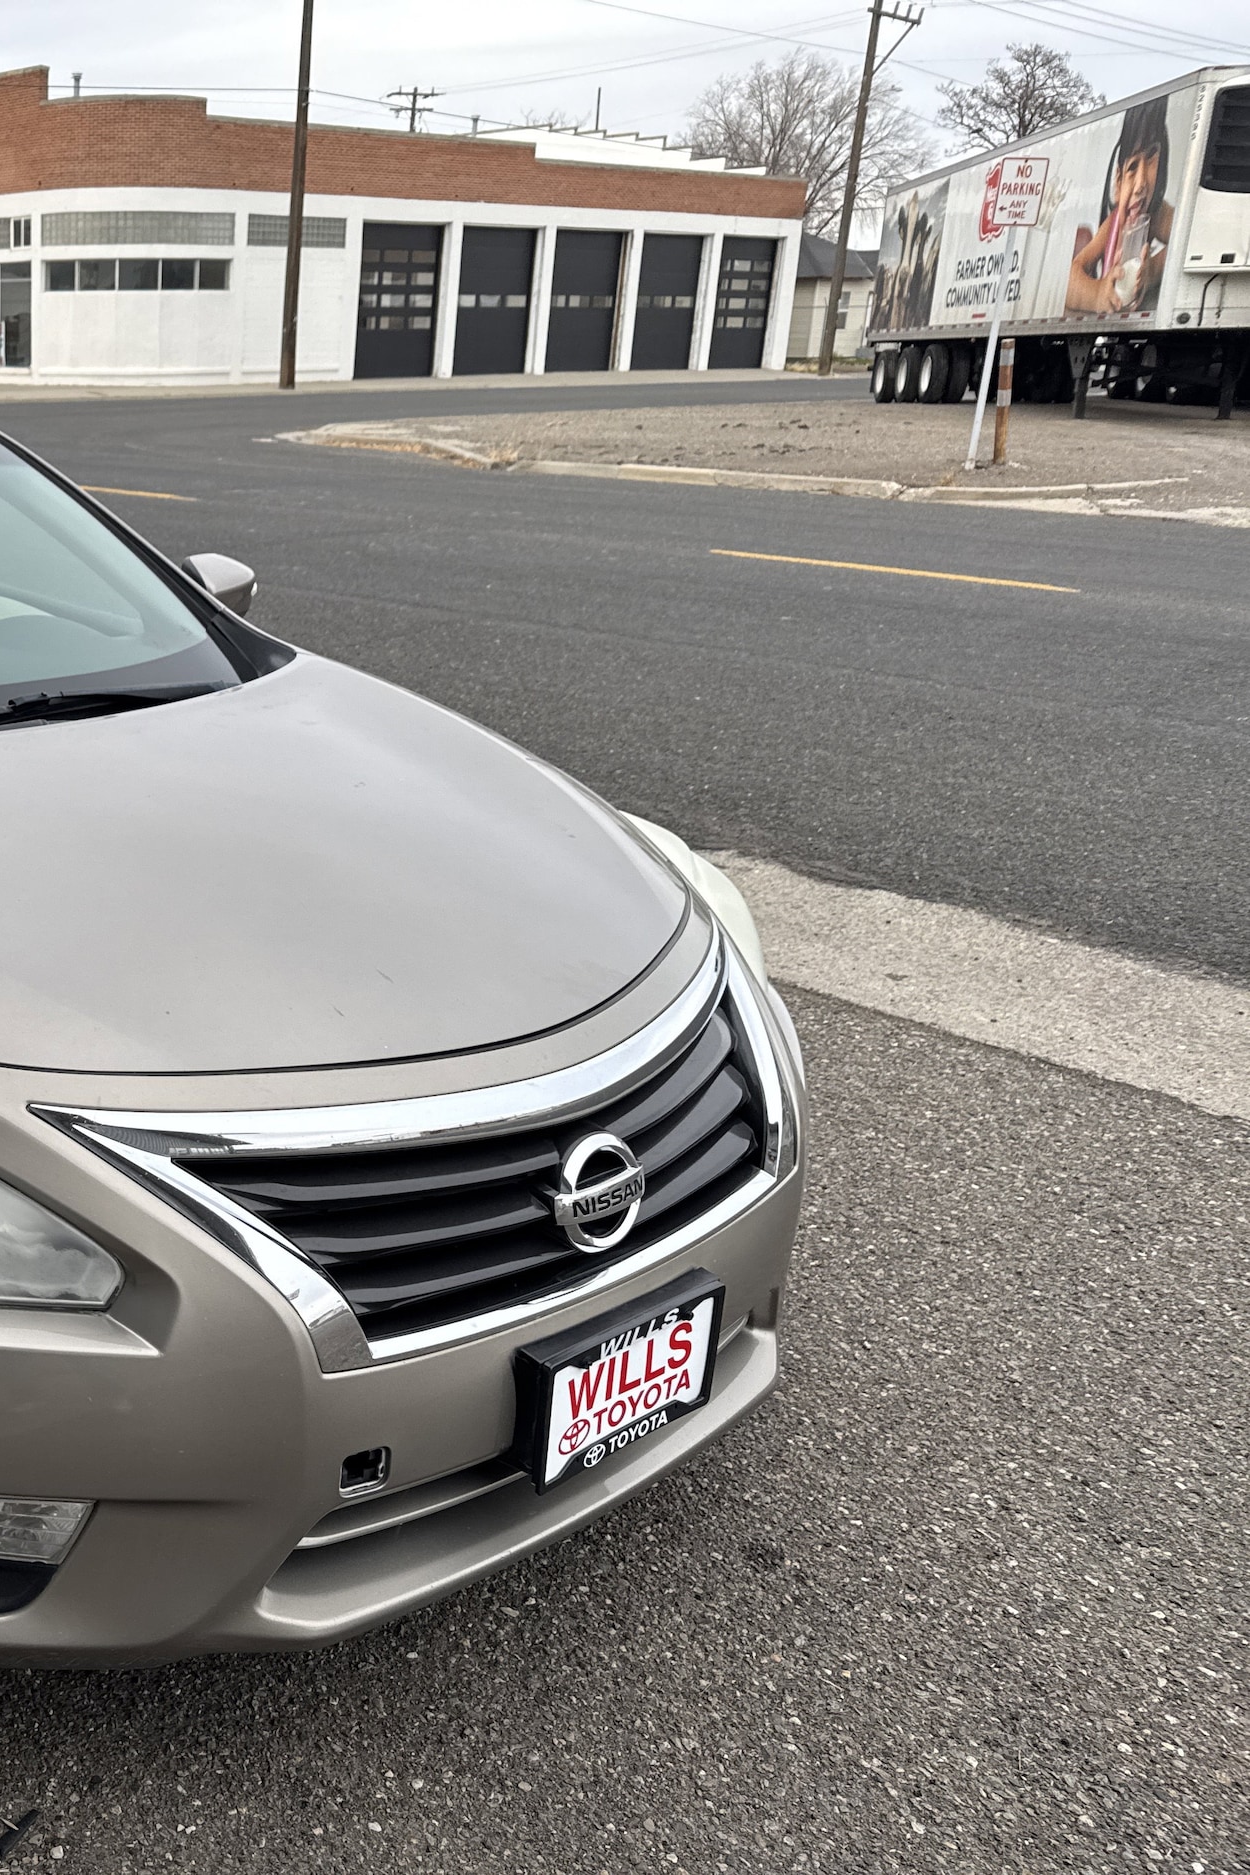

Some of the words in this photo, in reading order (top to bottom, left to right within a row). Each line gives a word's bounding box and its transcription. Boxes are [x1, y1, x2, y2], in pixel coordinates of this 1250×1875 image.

[1016, 164, 1033, 178] NO
[1000, 182, 1042, 196] PARKING
[1007, 210, 1027, 220] TIME
[1009, 199, 1029, 209] ANY
[956, 256, 986, 281] FARMER
[946, 282, 993, 308] COMMUNITY
[571, 1175, 645, 1219] NISSAN
[599, 1306, 681, 1359] WILLS
[568, 1321, 693, 1420] WILLS
[592, 1367, 691, 1436] TOYOTA
[608, 1413, 669, 1454] TOYOTA
